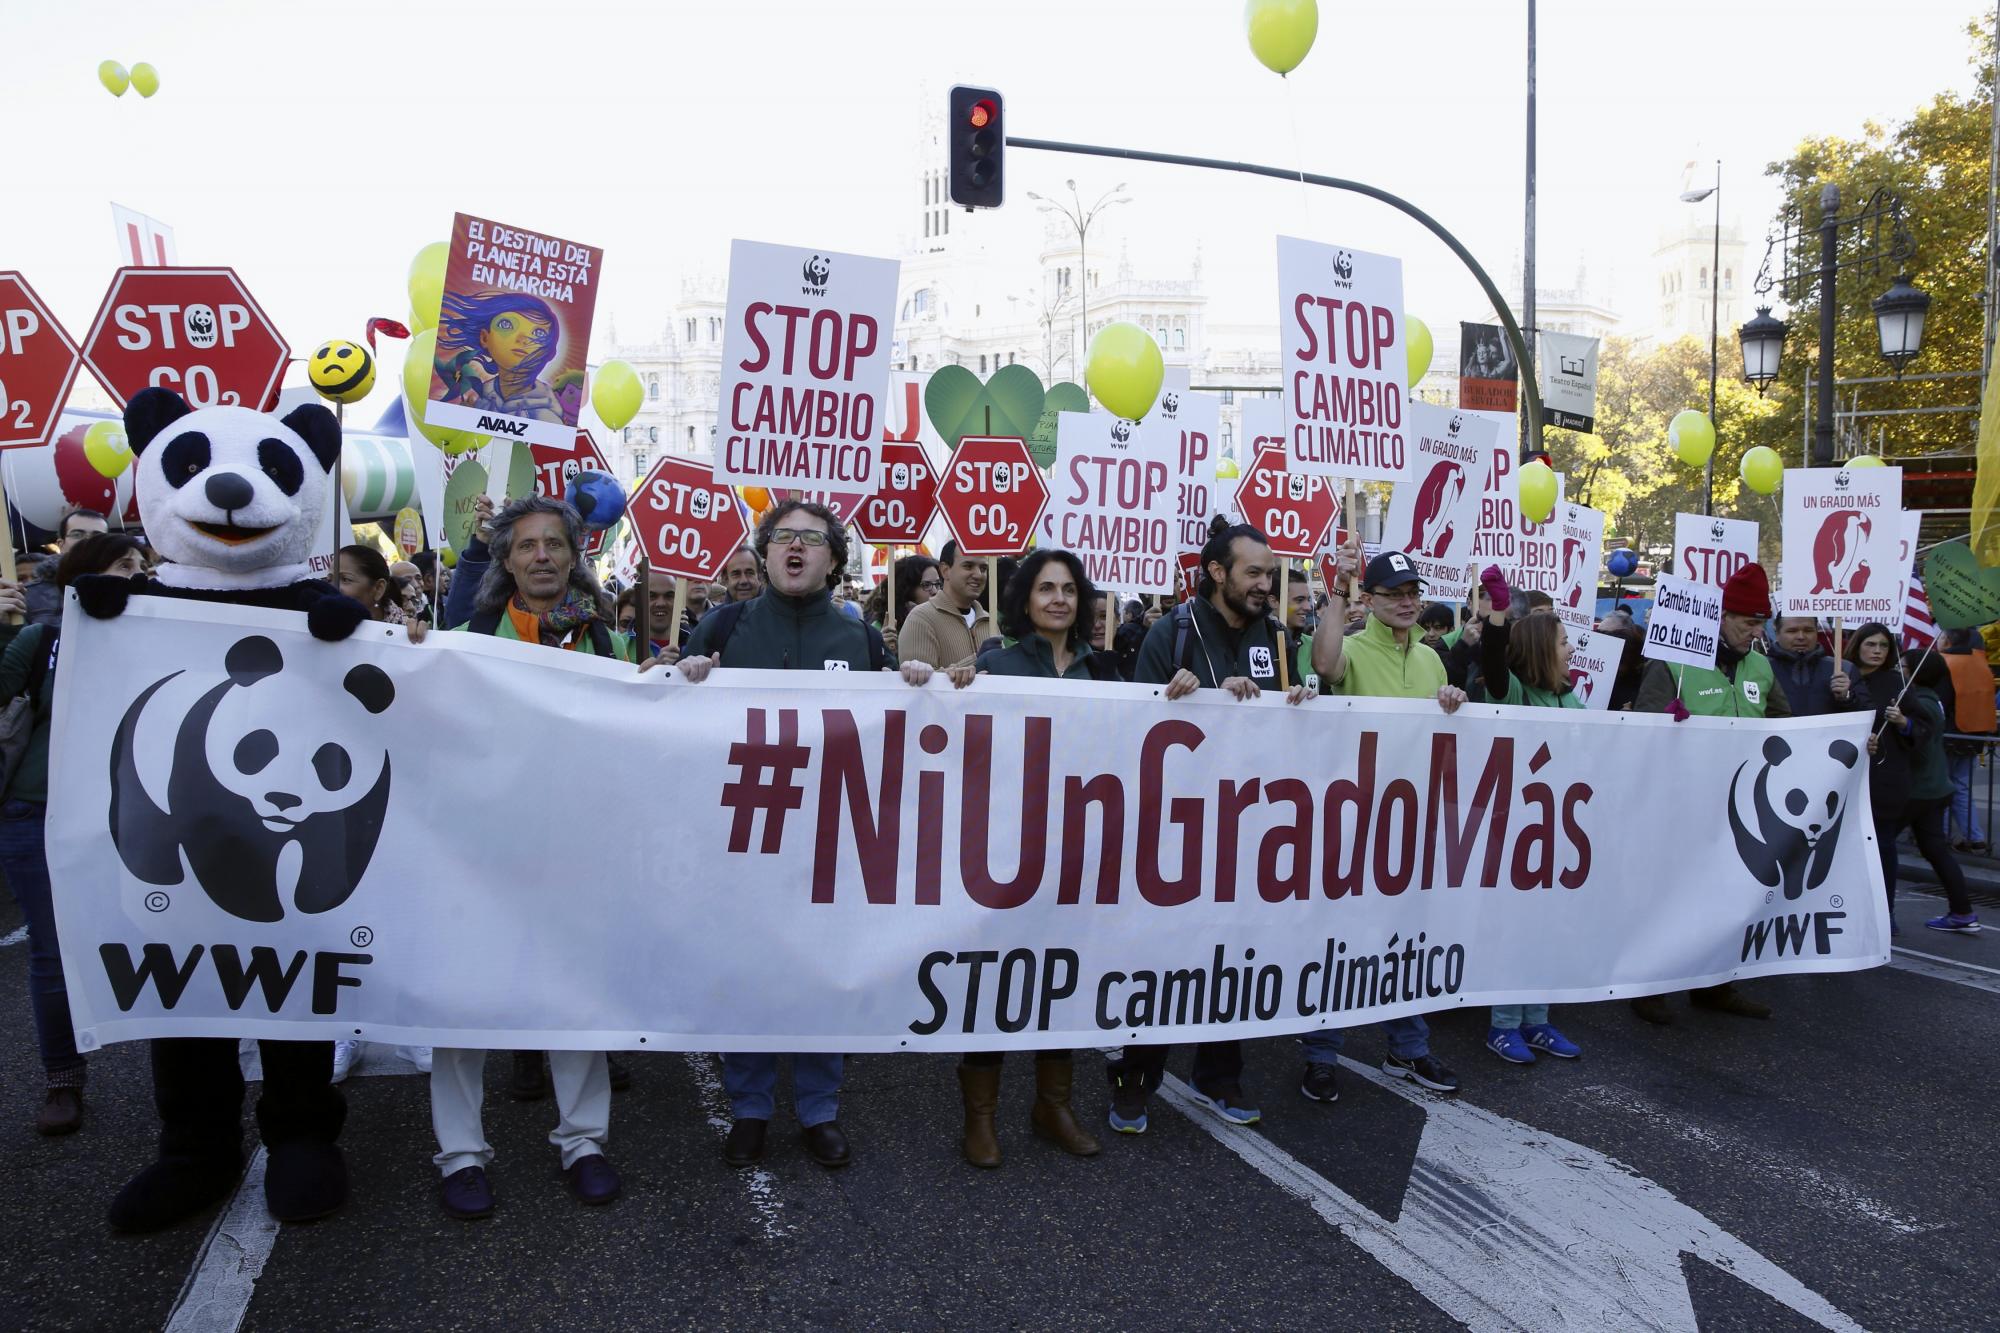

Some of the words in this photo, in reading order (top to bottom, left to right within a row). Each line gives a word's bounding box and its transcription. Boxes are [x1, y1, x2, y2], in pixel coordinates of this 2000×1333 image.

[468, 220, 486, 241] EL
[491, 225, 560, 257] DESTINO
[564, 243, 592, 268] DEL
[466, 241, 542, 274] PLANETA
[546, 260, 589, 286] ESTÁ
[471, 263, 494, 285] EN
[497, 270, 574, 303] MARCHA
[801, 286, 828, 297] WWF
[1334, 279, 1353, 290] WWF
[115, 303, 250, 351] STOP
[738, 301, 879, 382] STOP
[1294, 292, 1395, 371] STOP
[1549, 375, 1571, 386] Teatro
[730, 381, 875, 442] CAMBIO
[1161, 412, 1177, 420] WWF
[1293, 370, 1401, 430] CAMBIO
[476, 415, 529, 437] AVAAZ
[724, 434, 873, 483] CLIMÁTICO
[1293, 423, 1405, 470] CLIMÁTICO
[1419, 436, 1432, 452] UN
[1432, 440, 1458, 460] GRADO
[1459, 445, 1478, 465] MÁS
[955, 460, 1030, 495] STOP
[1067, 454, 1168, 511] STOP
[1254, 468, 1323, 503] STOP
[649, 479, 732, 522] STOP
[1475, 498, 1514, 531] BIO
[1803, 495, 1817, 509] UN
[1820, 495, 1855, 508] GRADO
[1857, 492, 1881, 508] MÁS
[1061, 511, 1168, 556] CAMBIO
[1470, 530, 1515, 557] ÁTICO
[1579, 526, 1592, 542] MÁS
[1073, 551, 1168, 587] IMÁTICO
[1433, 564, 1461, 583] MENOS
[1440, 586, 1468, 599] BOSQUE
[1657, 584, 1691, 616] Cambia
[1692, 597, 1701, 616] tu
[1789, 598, 1810, 611] UNA
[1812, 598, 1852, 611] ESPECIE
[1855, 598, 1891, 611] MENOS
[1571, 611, 1591, 626] MENOS
[1649, 623, 1668, 642] no
[1671, 623, 1681, 646] tu
[1684, 627, 1715, 654] clima.
[1587, 657, 1606, 672] MÁS
[720, 707, 1594, 910] #NiUnGradoMás
[1740, 911, 1847, 963] WWF
[98, 942, 374, 1015] WWF
[908, 947, 1080, 1036] STOP
[1095, 944, 1284, 1031] cambio
[1296, 930, 1465, 1018] climático
